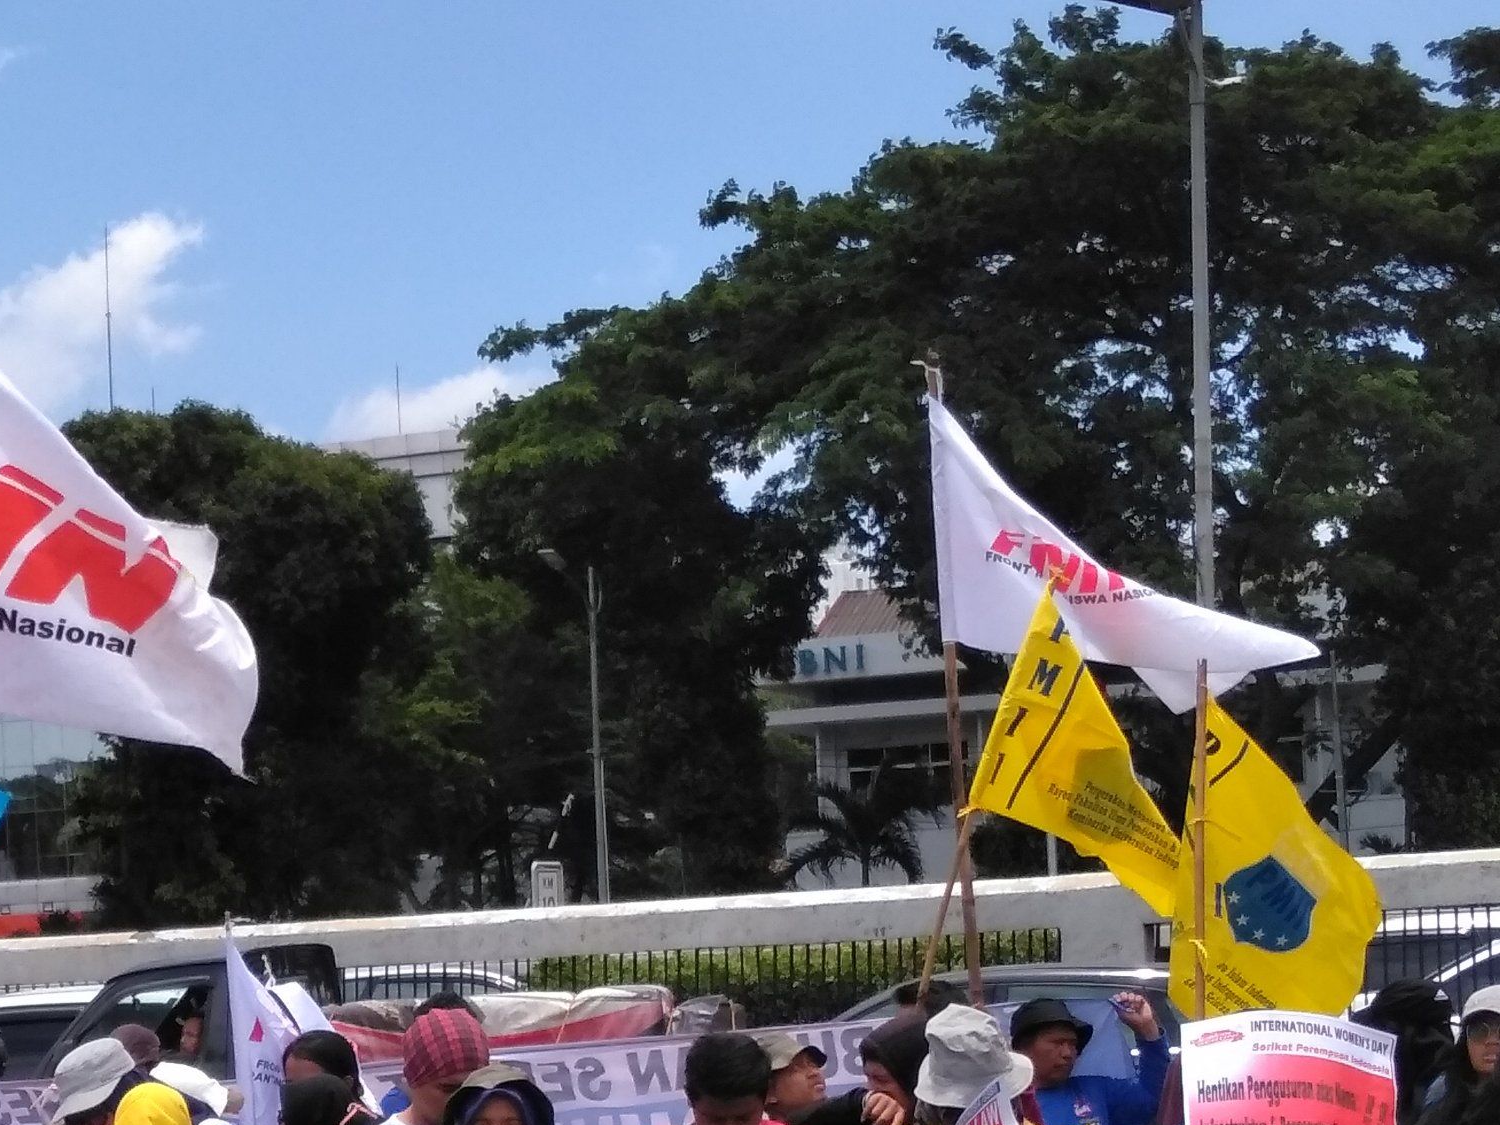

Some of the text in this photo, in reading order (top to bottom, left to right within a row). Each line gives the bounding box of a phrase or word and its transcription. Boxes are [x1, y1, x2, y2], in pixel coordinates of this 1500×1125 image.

[985, 551, 1032, 575] FRONT
[799, 643, 864, 675] BNI
[1250, 1021, 1333, 1038] INTERNATIONAL
[1335, 1028, 1371, 1050] WOMEN'S
[1371, 1040, 1389, 1055] DAY
[1252, 1043, 1293, 1052] Serikat
[1197, 1077, 1245, 1103] Hentikan
[1247, 1076, 1313, 1107] Penggusuran
